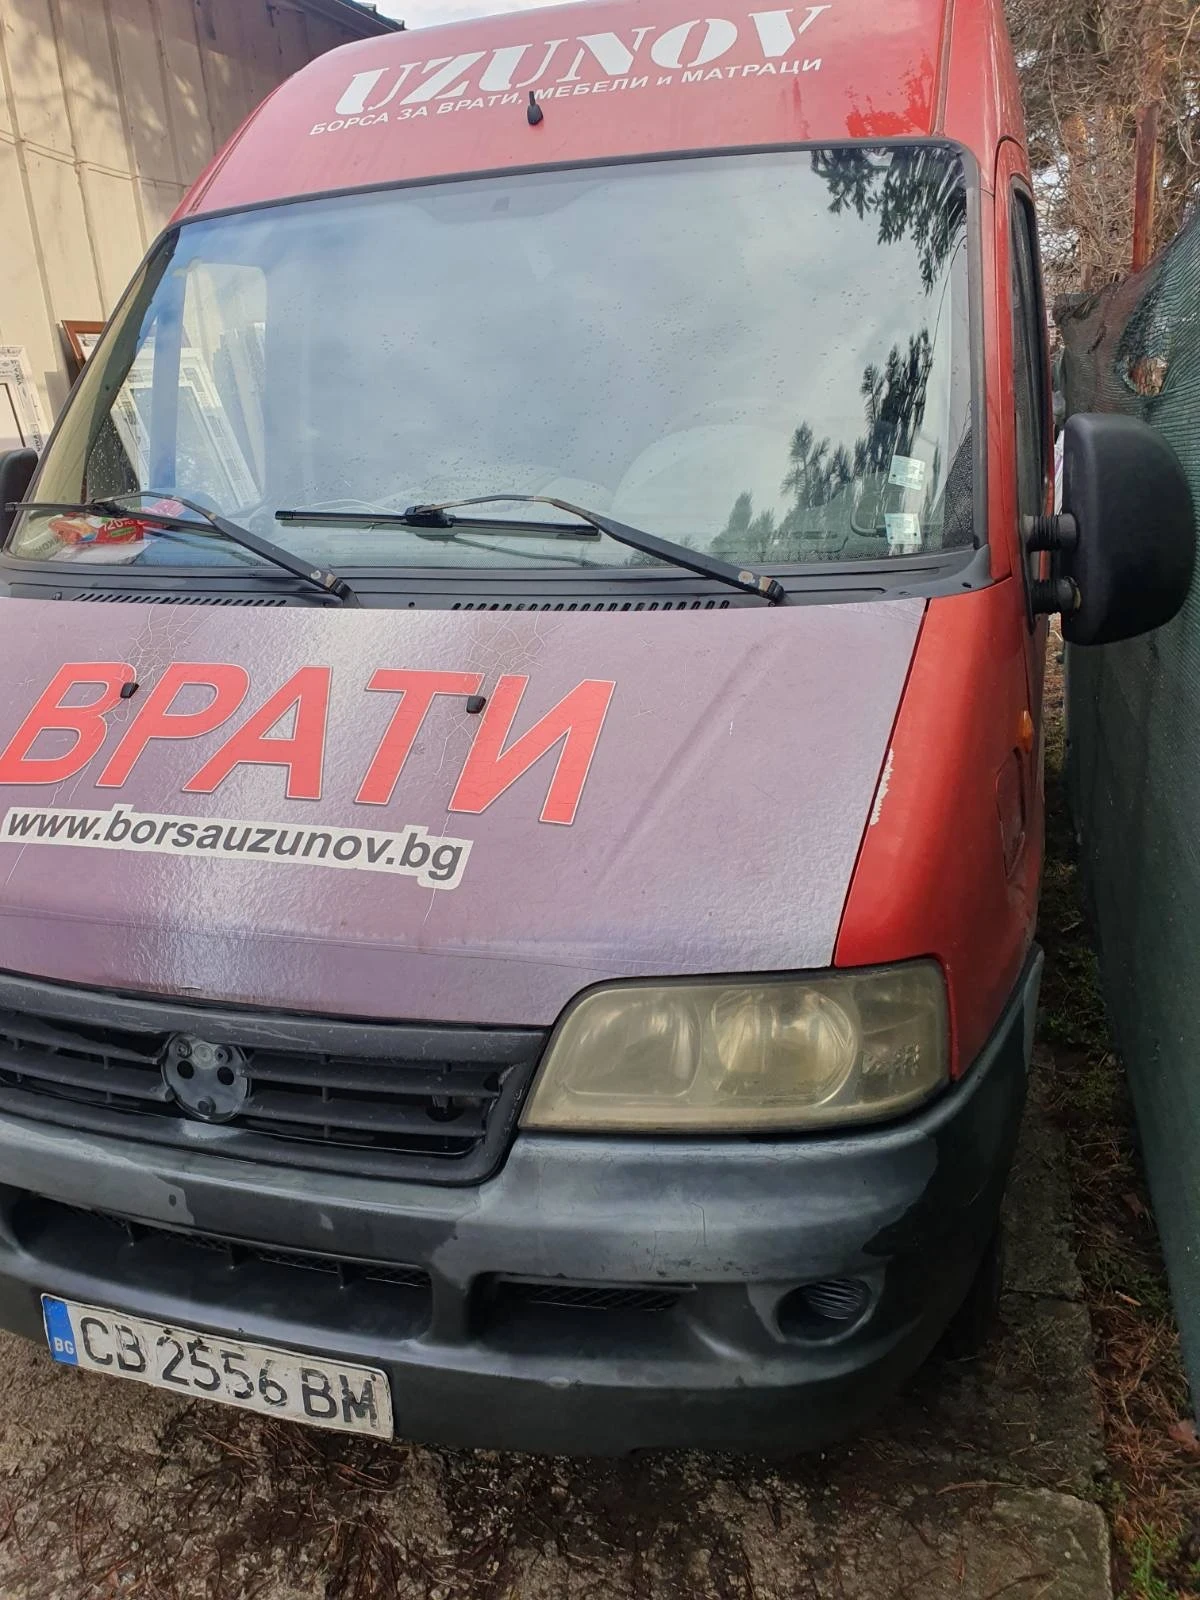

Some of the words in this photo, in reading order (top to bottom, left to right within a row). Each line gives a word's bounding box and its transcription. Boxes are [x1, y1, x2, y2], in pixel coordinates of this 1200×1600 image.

[309, 113, 389, 136] БОРСА
[396, 107, 428, 121] ЗА
[436, 92, 523, 115] ВРАТИ,
[532, 75, 649, 101] МЕБЕЛИ
[680, 58, 823, 84] МАТРАЦИ
[334, 4, 832, 115] UZUNOV
[0, 661, 616, 826] ВРАТИ
[7, 809, 464, 881] www.borsauzunov.bg
[54, 1336, 75, 1355] BG
